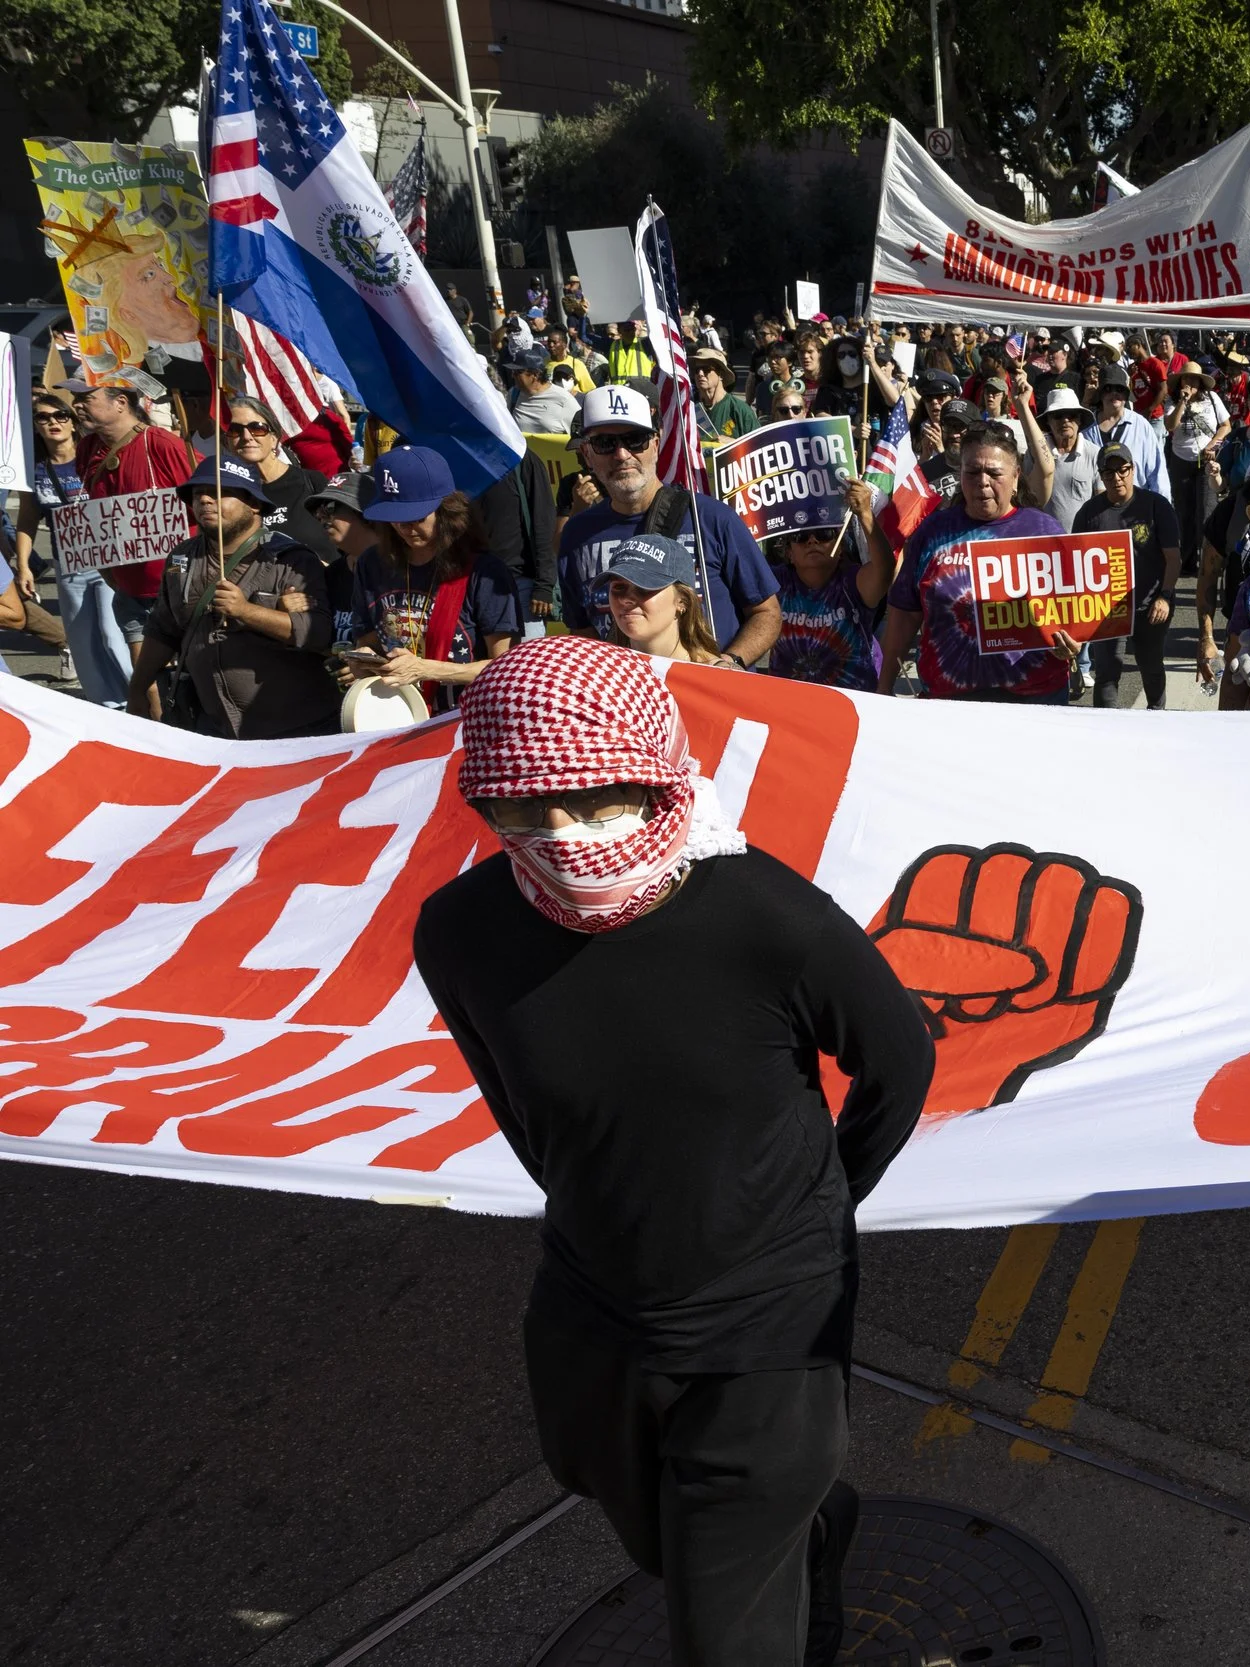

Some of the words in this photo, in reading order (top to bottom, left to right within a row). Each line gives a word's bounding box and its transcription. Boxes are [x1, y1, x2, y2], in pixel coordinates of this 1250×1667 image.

[297, 31, 312, 49] St
[54, 168, 87, 184] The
[92, 166, 144, 186] Grifter
[148, 164, 185, 183] King
[1144, 219, 1217, 258] WITH
[943, 231, 1106, 304] IMMIGRANT
[1114, 241, 1244, 305] FAMILIES
[608, 389, 629, 415] LA
[384, 469, 399, 493] LA
[720, 441, 794, 494] UNITED
[796, 434, 848, 467] FOR
[747, 467, 850, 512] SCHOOLS
[55, 503, 90, 529] KPFK
[100, 499, 124, 519] LA
[162, 494, 182, 512] FM
[767, 516, 784, 526] SEIU
[58, 525, 96, 550] KPFA
[163, 513, 185, 532] FM
[65, 544, 121, 573] PACIFICA
[124, 532, 185, 560] NETWORK
[636, 541, 666, 564] BEACH
[977, 548, 1110, 600] PUBLIC
[381, 594, 396, 609] NO
[982, 593, 1111, 631] EDUCATION
[986, 639, 1002, 648] UTLA
